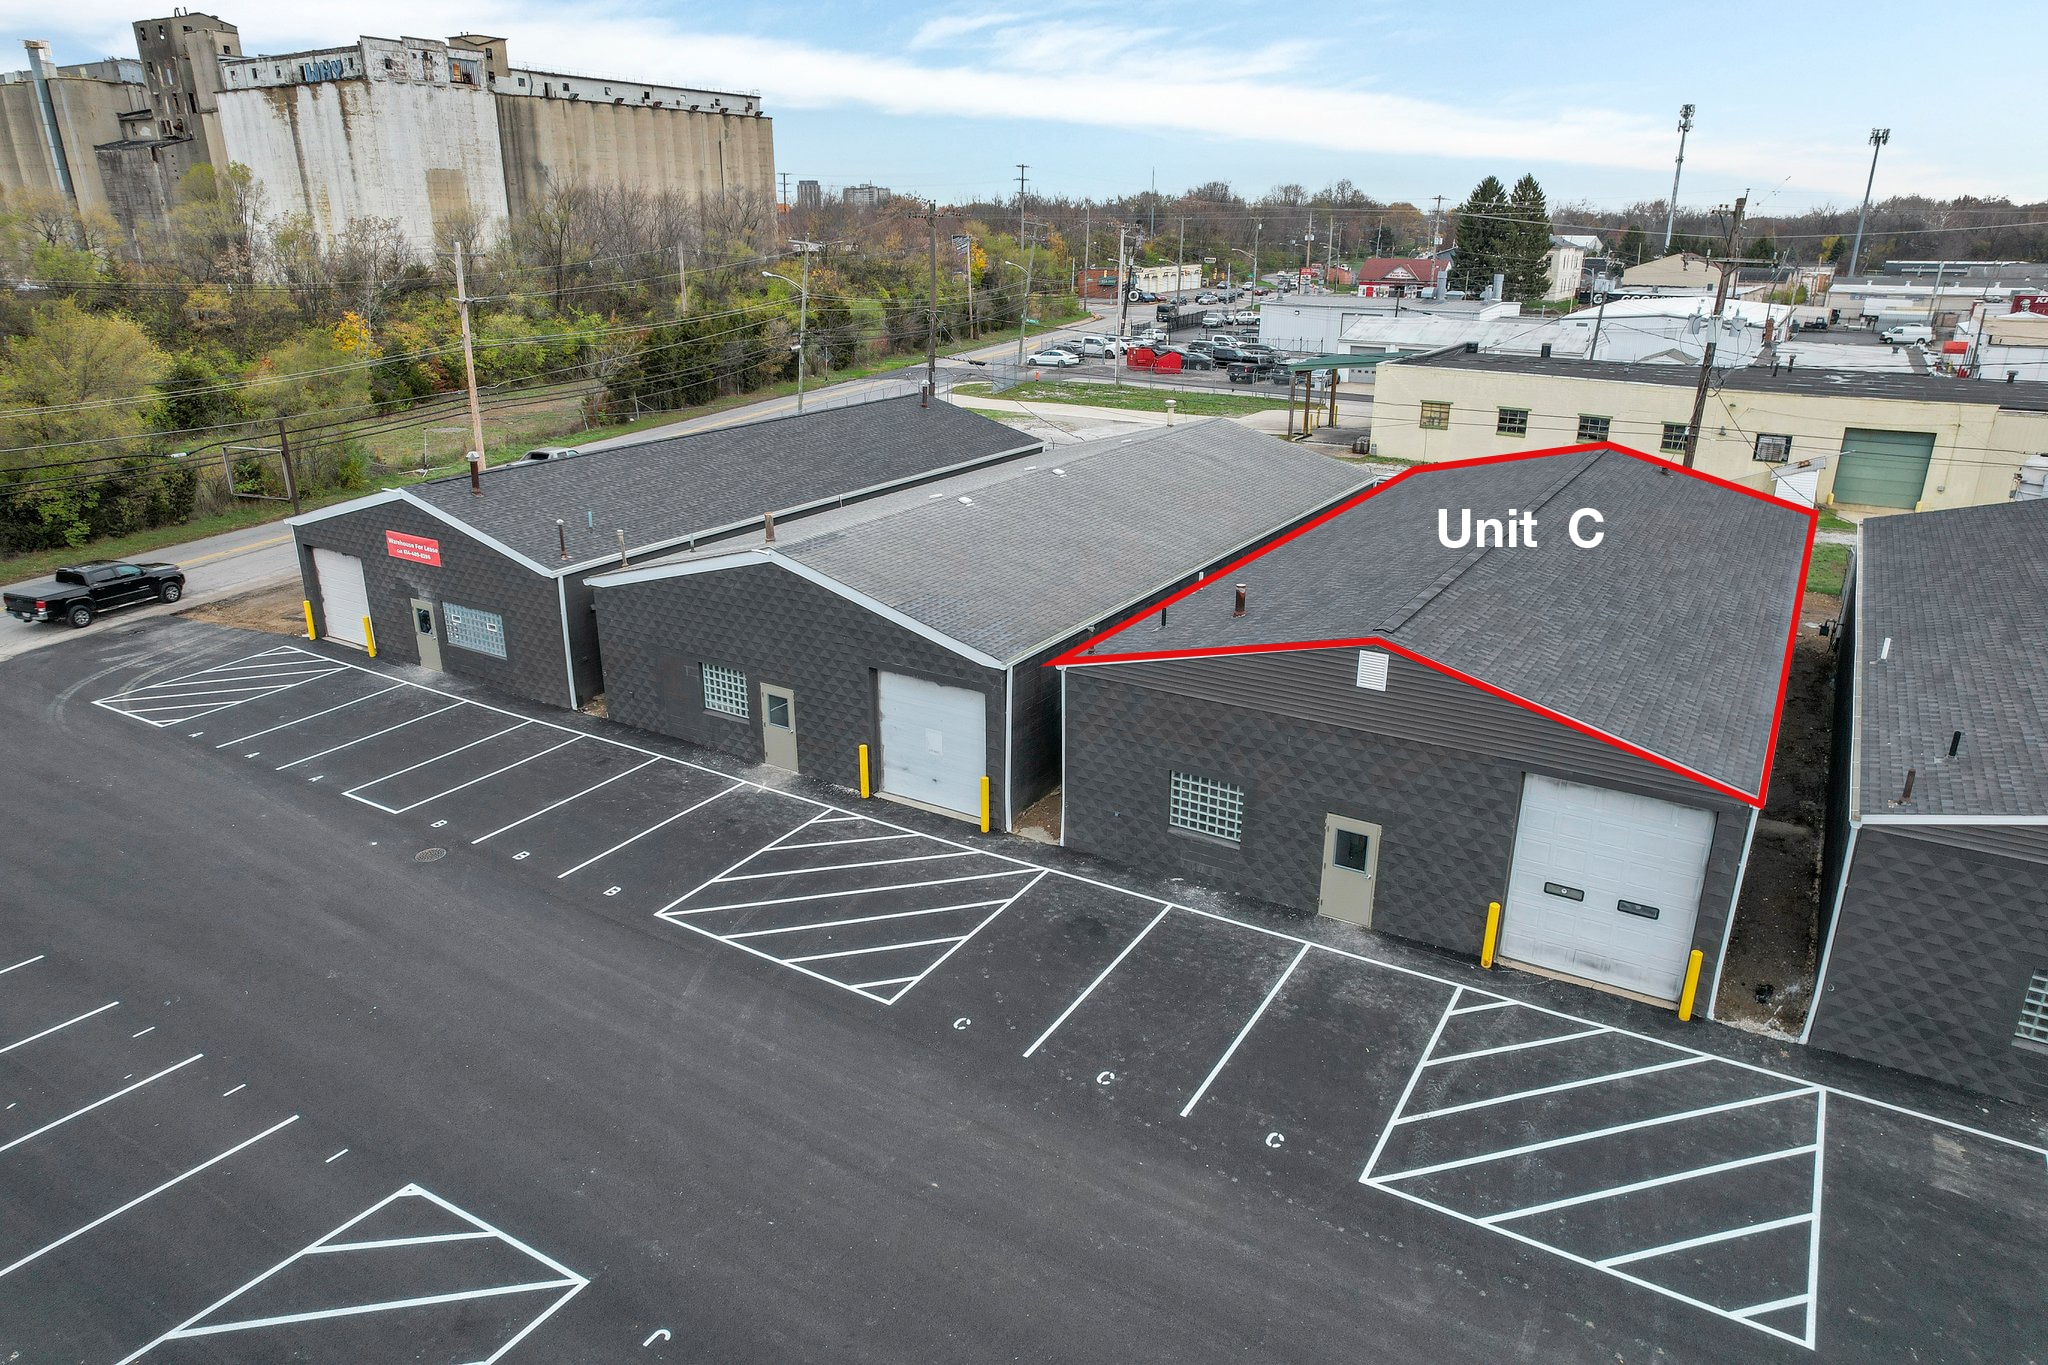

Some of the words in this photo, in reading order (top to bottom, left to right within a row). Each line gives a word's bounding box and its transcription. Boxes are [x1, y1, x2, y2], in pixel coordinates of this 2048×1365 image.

[304, 59, 343, 84] WHY
[388, 538, 415, 549] Warehouse
[424, 545, 438, 553] Lease
[511, 850, 531, 861] B
[602, 885, 623, 897] B
[952, 1017, 972, 1031] C
[1096, 1070, 1116, 1086] C
[1265, 1131, 1285, 1149] C
